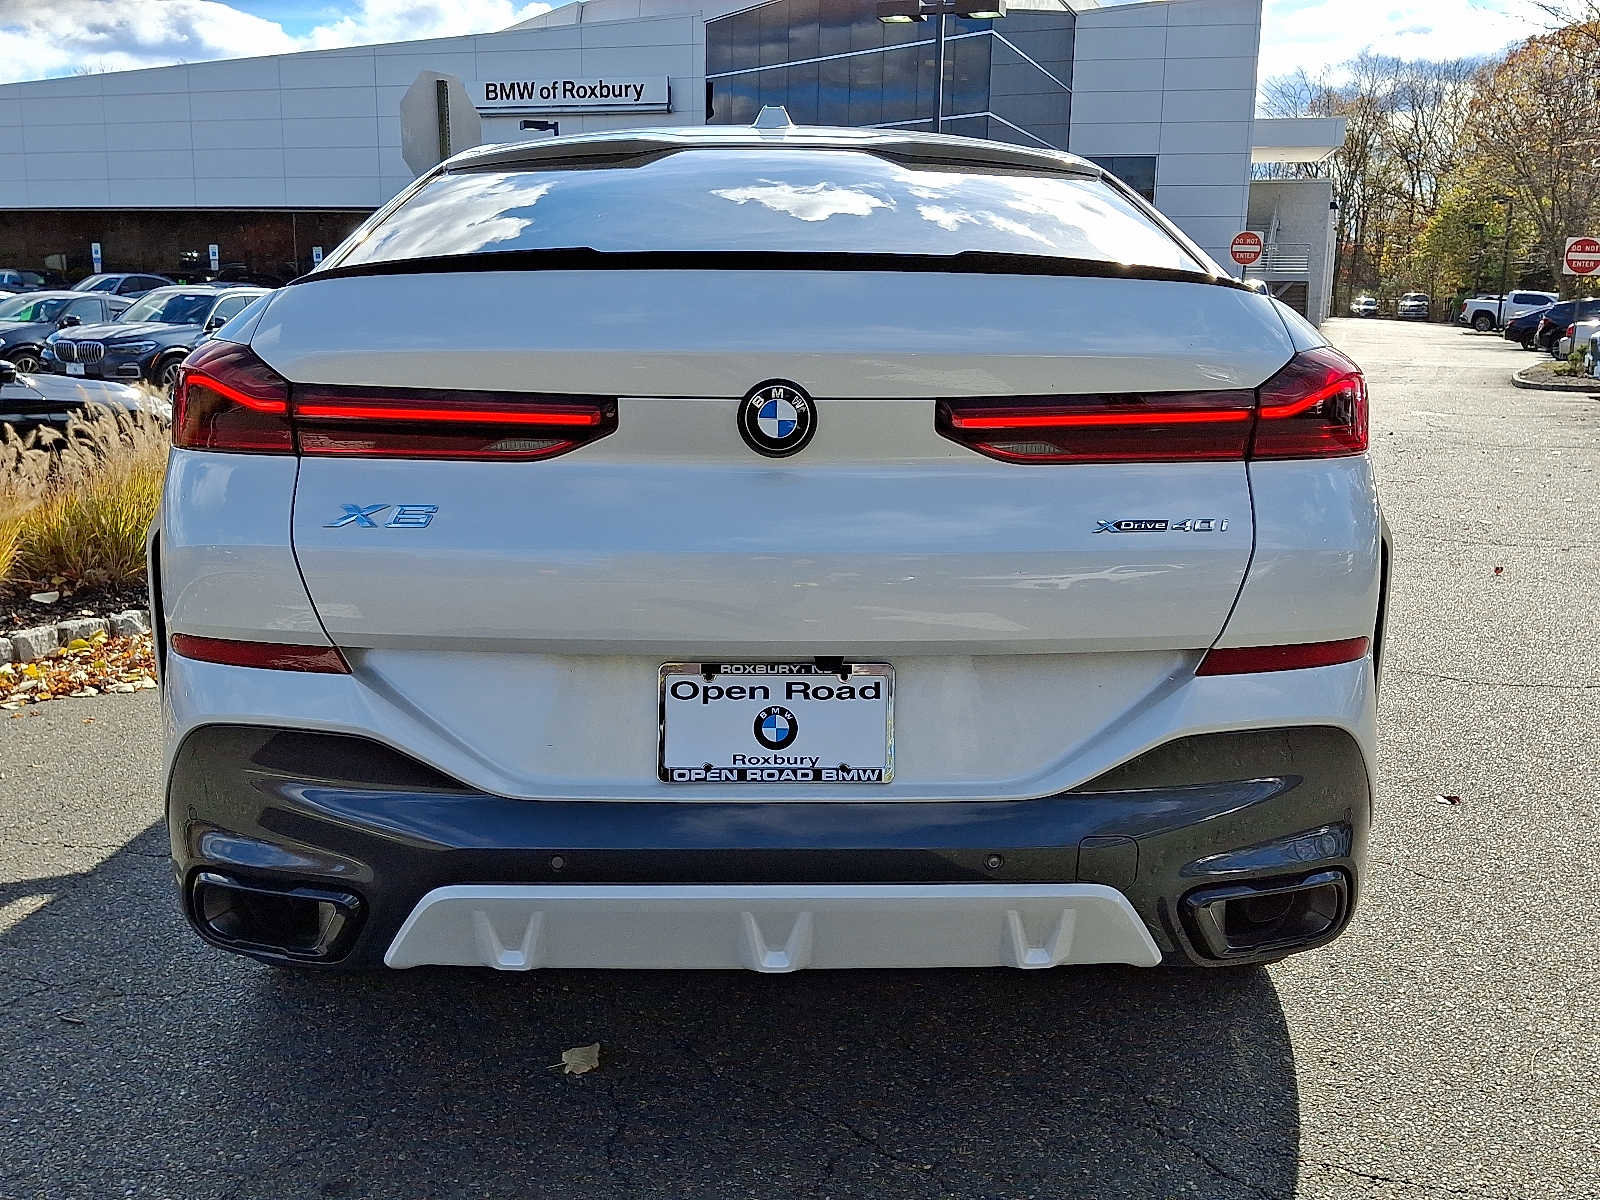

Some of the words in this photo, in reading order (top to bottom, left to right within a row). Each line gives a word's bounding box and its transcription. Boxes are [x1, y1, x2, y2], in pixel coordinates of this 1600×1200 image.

[485, 82, 535, 100] BMW
[539, 81, 559, 100] of
[562, 80, 645, 101] Roxbury
[752, 388, 806, 413] BMW
[321, 503, 440, 528] X6
[670, 680, 770, 705] Open
[785, 681, 881, 701] Road
[759, 707, 793, 720] BMW
[732, 753, 820, 768] Roxbury
[673, 769, 738, 782] OPEN
[746, 769, 814, 782] ROAD
[821, 769, 880, 782] BMW
